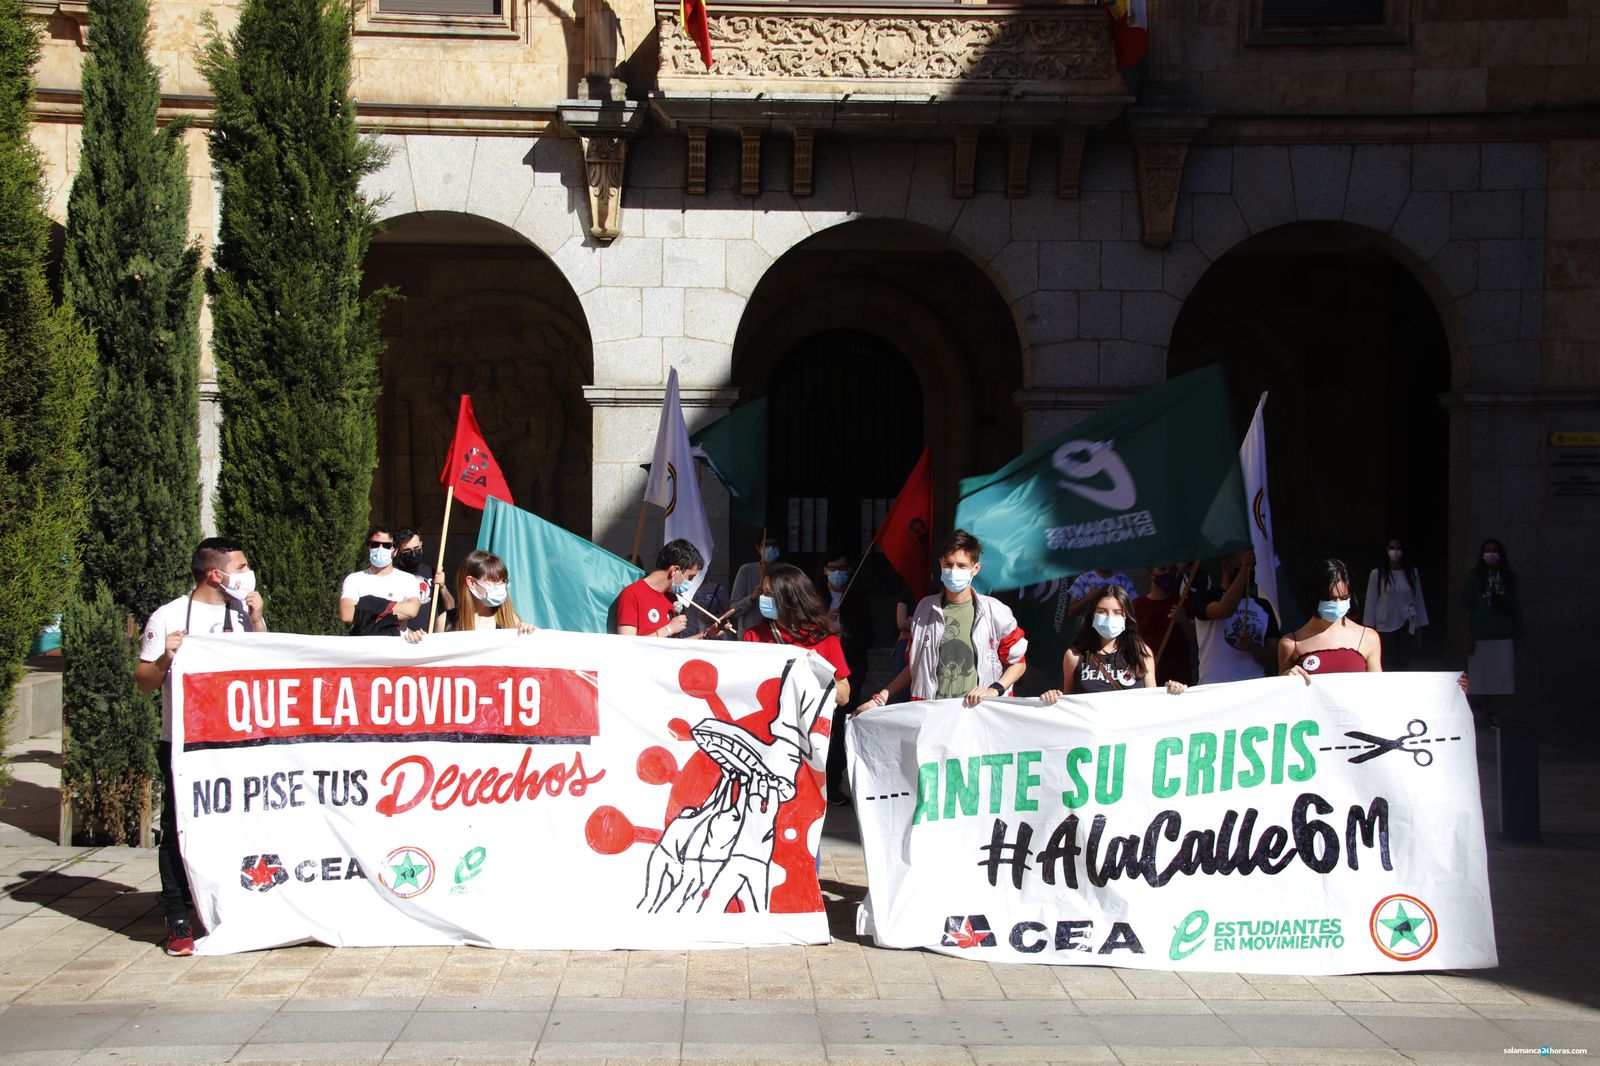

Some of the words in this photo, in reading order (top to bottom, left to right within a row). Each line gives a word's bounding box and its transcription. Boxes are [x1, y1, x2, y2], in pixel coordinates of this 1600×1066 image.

[227, 679, 300, 733] QUE
[312, 677, 360, 726] LA
[370, 676, 541, 727] COVID-19
[193, 777, 232, 818] NO
[243, 770, 305, 813] PISE
[312, 769, 368, 807] TUS
[375, 746, 607, 817] Derechos
[911, 750, 1043, 826] ANTE
[1061, 744, 1128, 809] SU
[1151, 719, 1320, 799] CRISIS
[294, 856, 368, 884] CEA
[1008, 920, 1146, 955] CEA
[1213, 918, 1342, 937] ESTUDIANTES
[1214, 937, 1236, 952] EN
[1239, 934, 1345, 951] MOVIMIENTO
